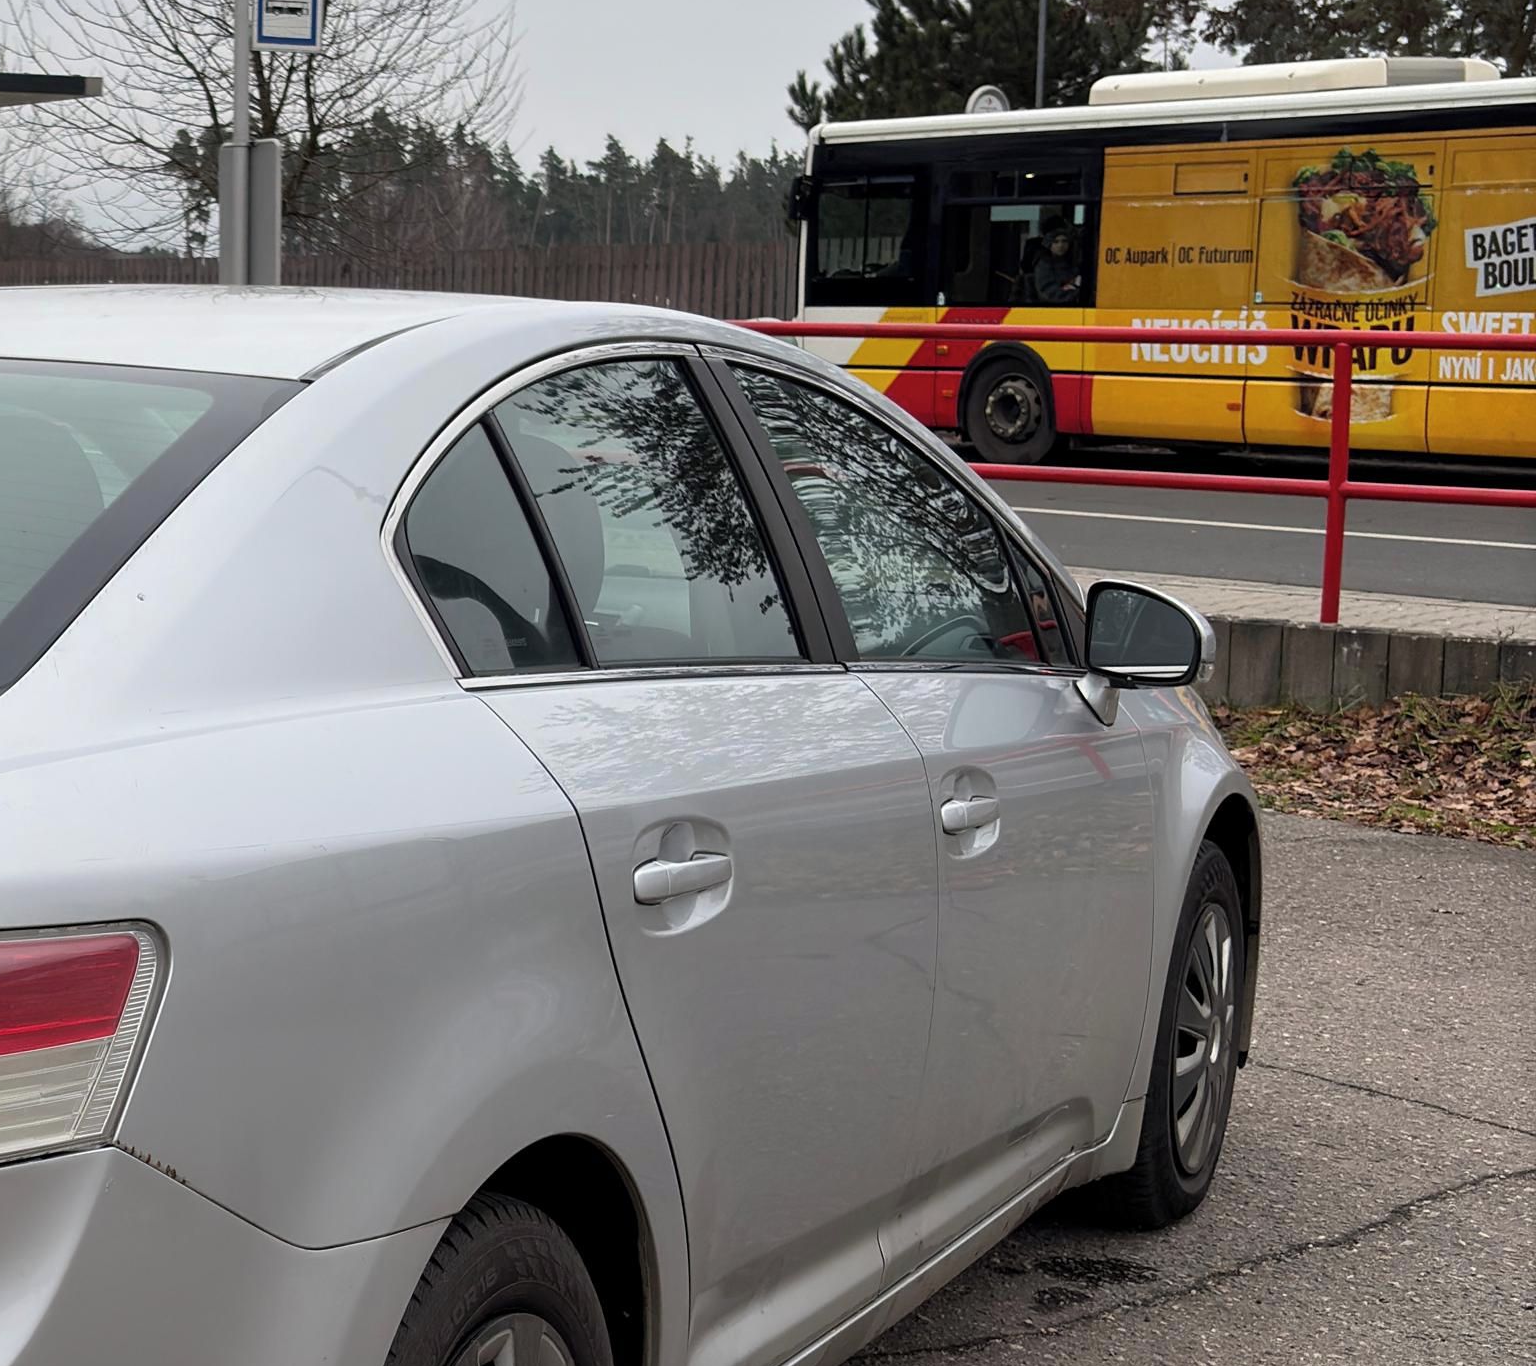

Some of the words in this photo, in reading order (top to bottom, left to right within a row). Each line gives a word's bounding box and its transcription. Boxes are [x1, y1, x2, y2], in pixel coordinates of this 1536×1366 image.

[1105, 248, 1120, 264] OC
[1124, 248, 1169, 266] Aupark
[1178, 247, 1194, 263] OC
[1198, 247, 1254, 263] Futurum
[1438, 351, 1481, 381] NYNÍ
[1488, 358, 1494, 381] I
